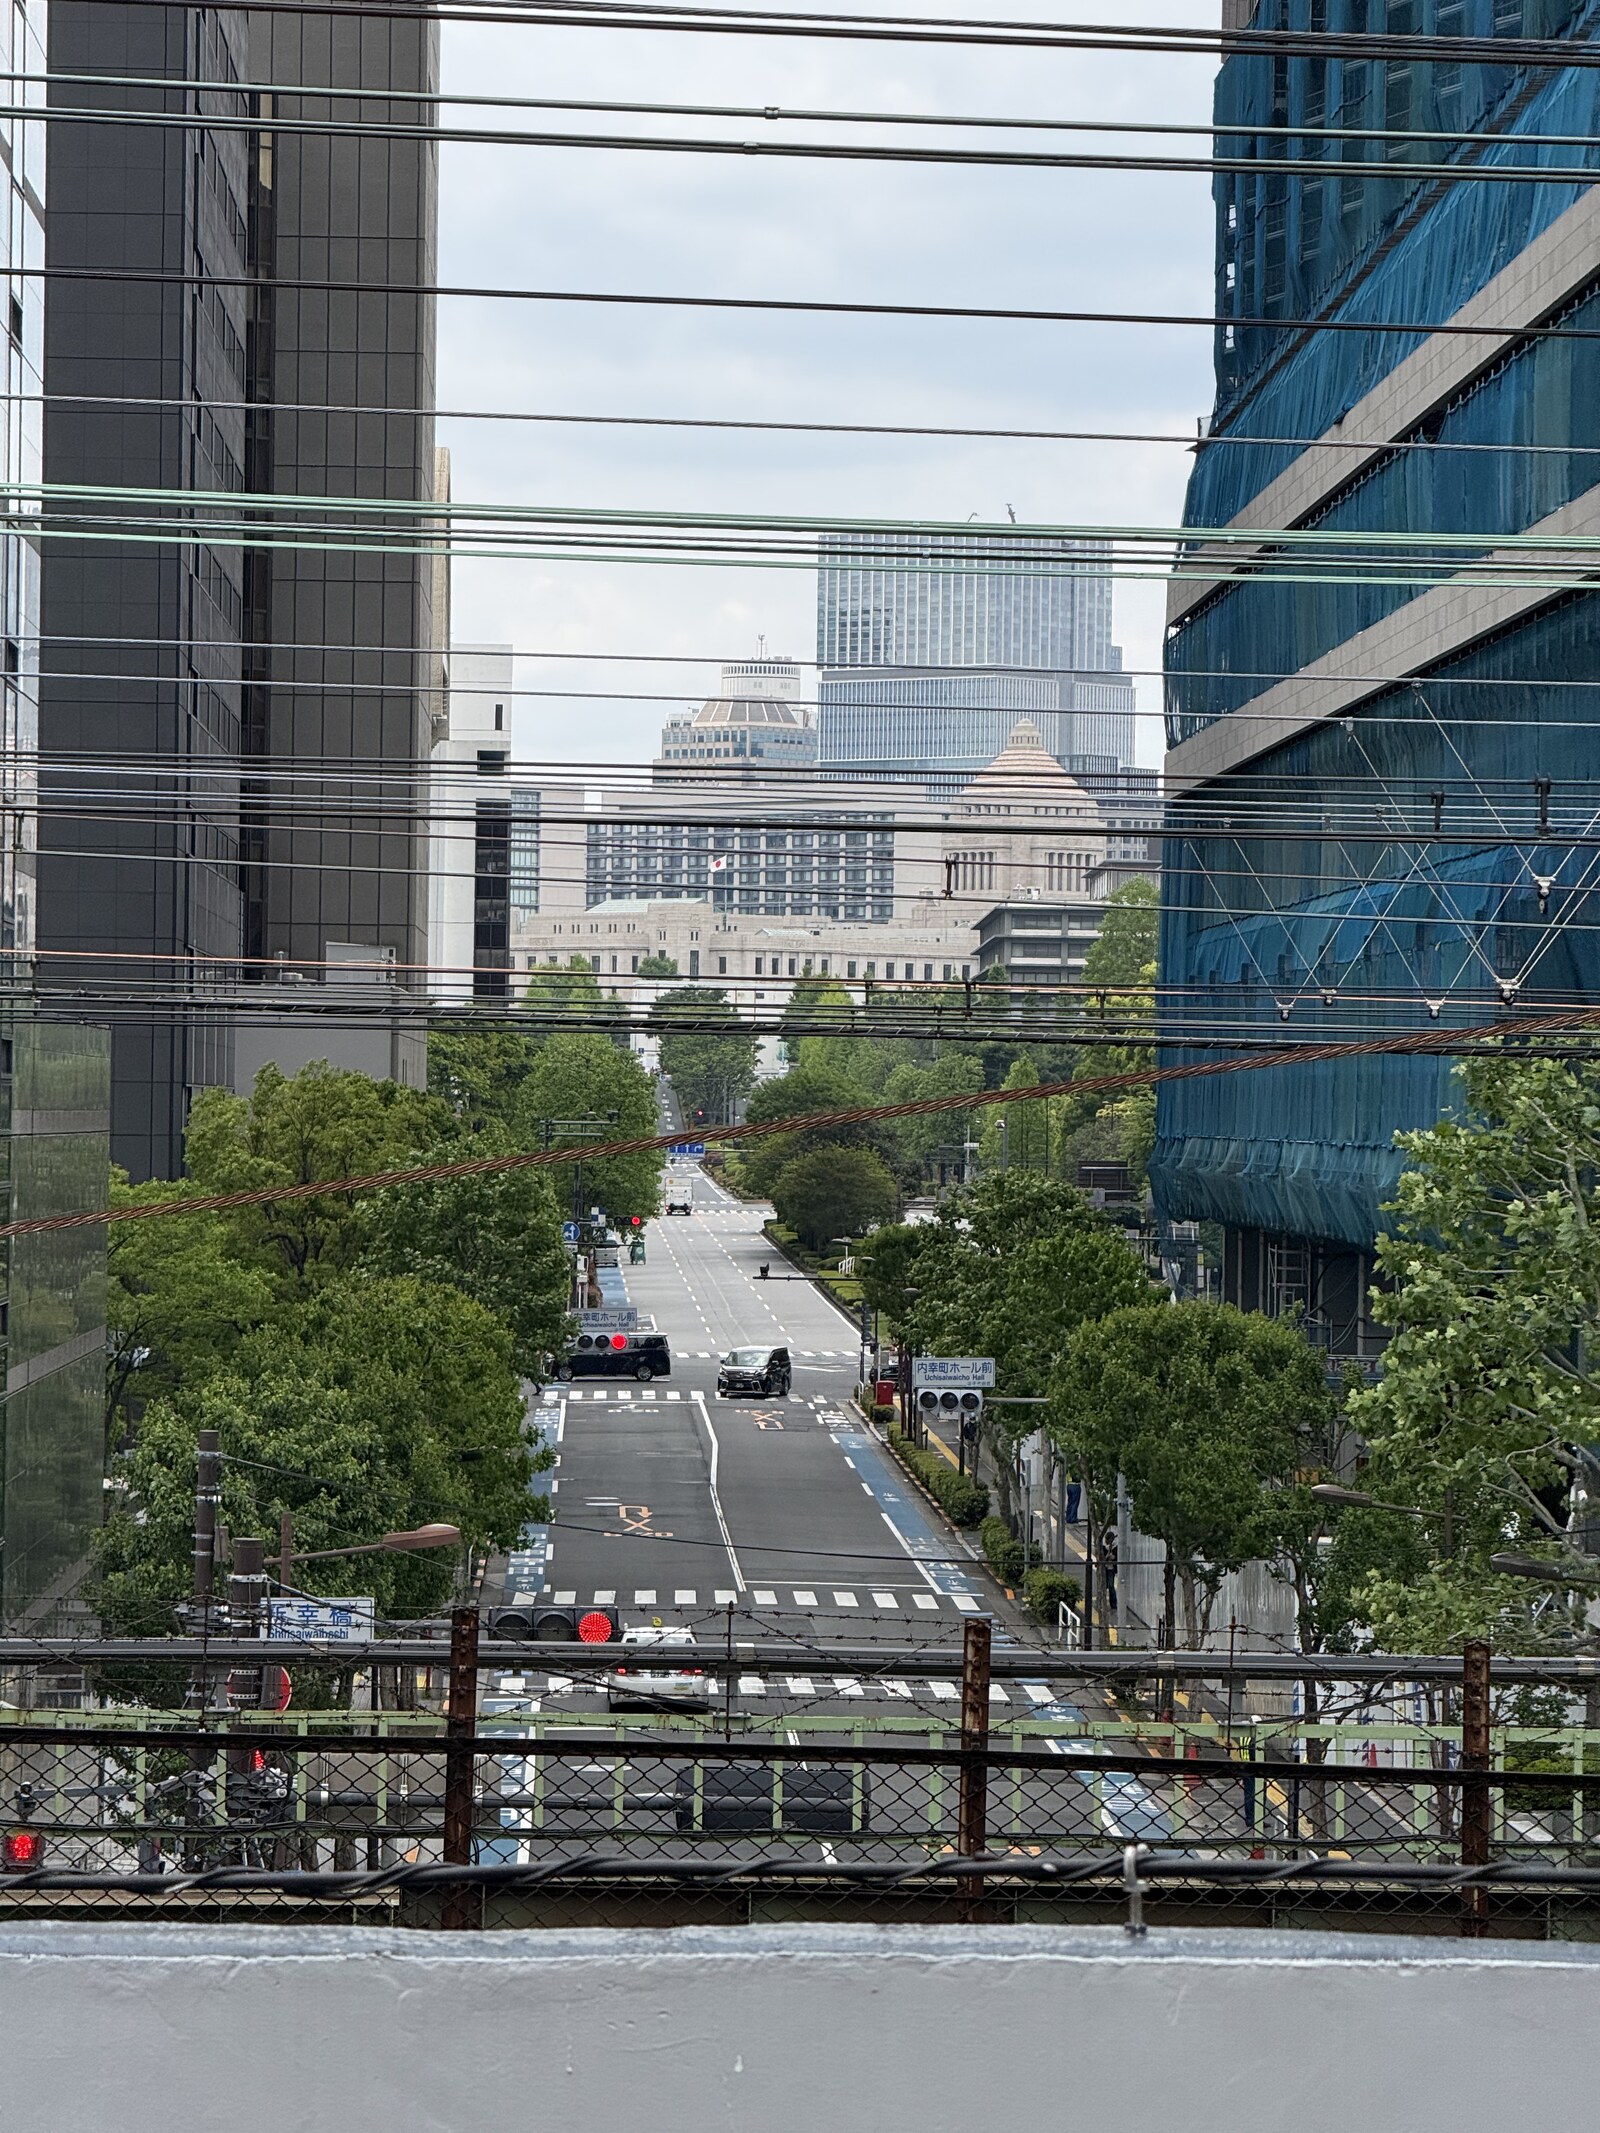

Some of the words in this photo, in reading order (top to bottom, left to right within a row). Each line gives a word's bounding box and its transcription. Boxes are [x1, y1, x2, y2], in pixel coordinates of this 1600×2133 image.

[917, 1361, 993, 1374] 内幸町ホール前
